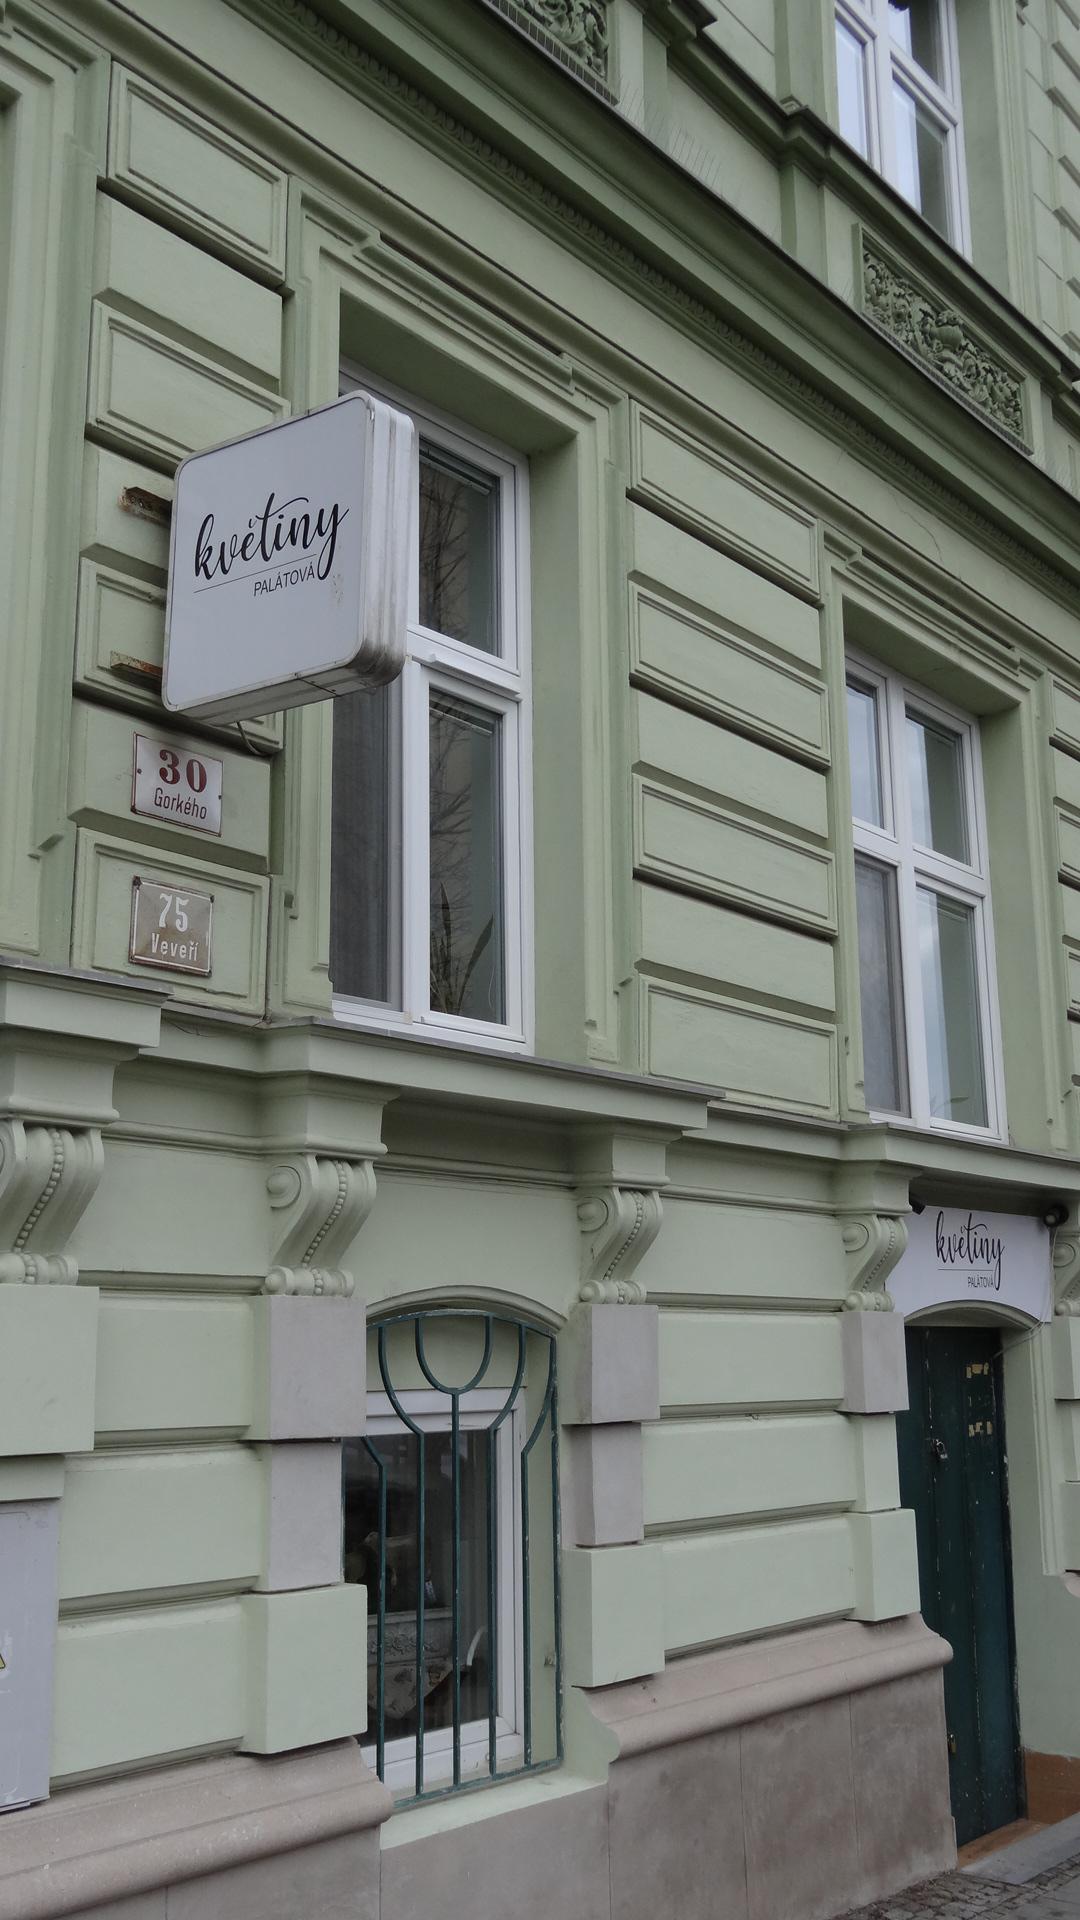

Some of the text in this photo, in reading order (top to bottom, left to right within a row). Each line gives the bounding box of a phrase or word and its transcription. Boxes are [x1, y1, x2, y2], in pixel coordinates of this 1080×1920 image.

[195, 492, 350, 580] květiny
[253, 561, 315, 597] PALÁTOVÁ
[159, 749, 208, 793] 30
[154, 787, 207, 820] Gorkého
[158, 893, 190, 932] 75
[151, 932, 198, 961] Veveří
[935, 1210, 1005, 1291] květiny
[967, 1275, 994, 1288] PALÁTOVÁ
